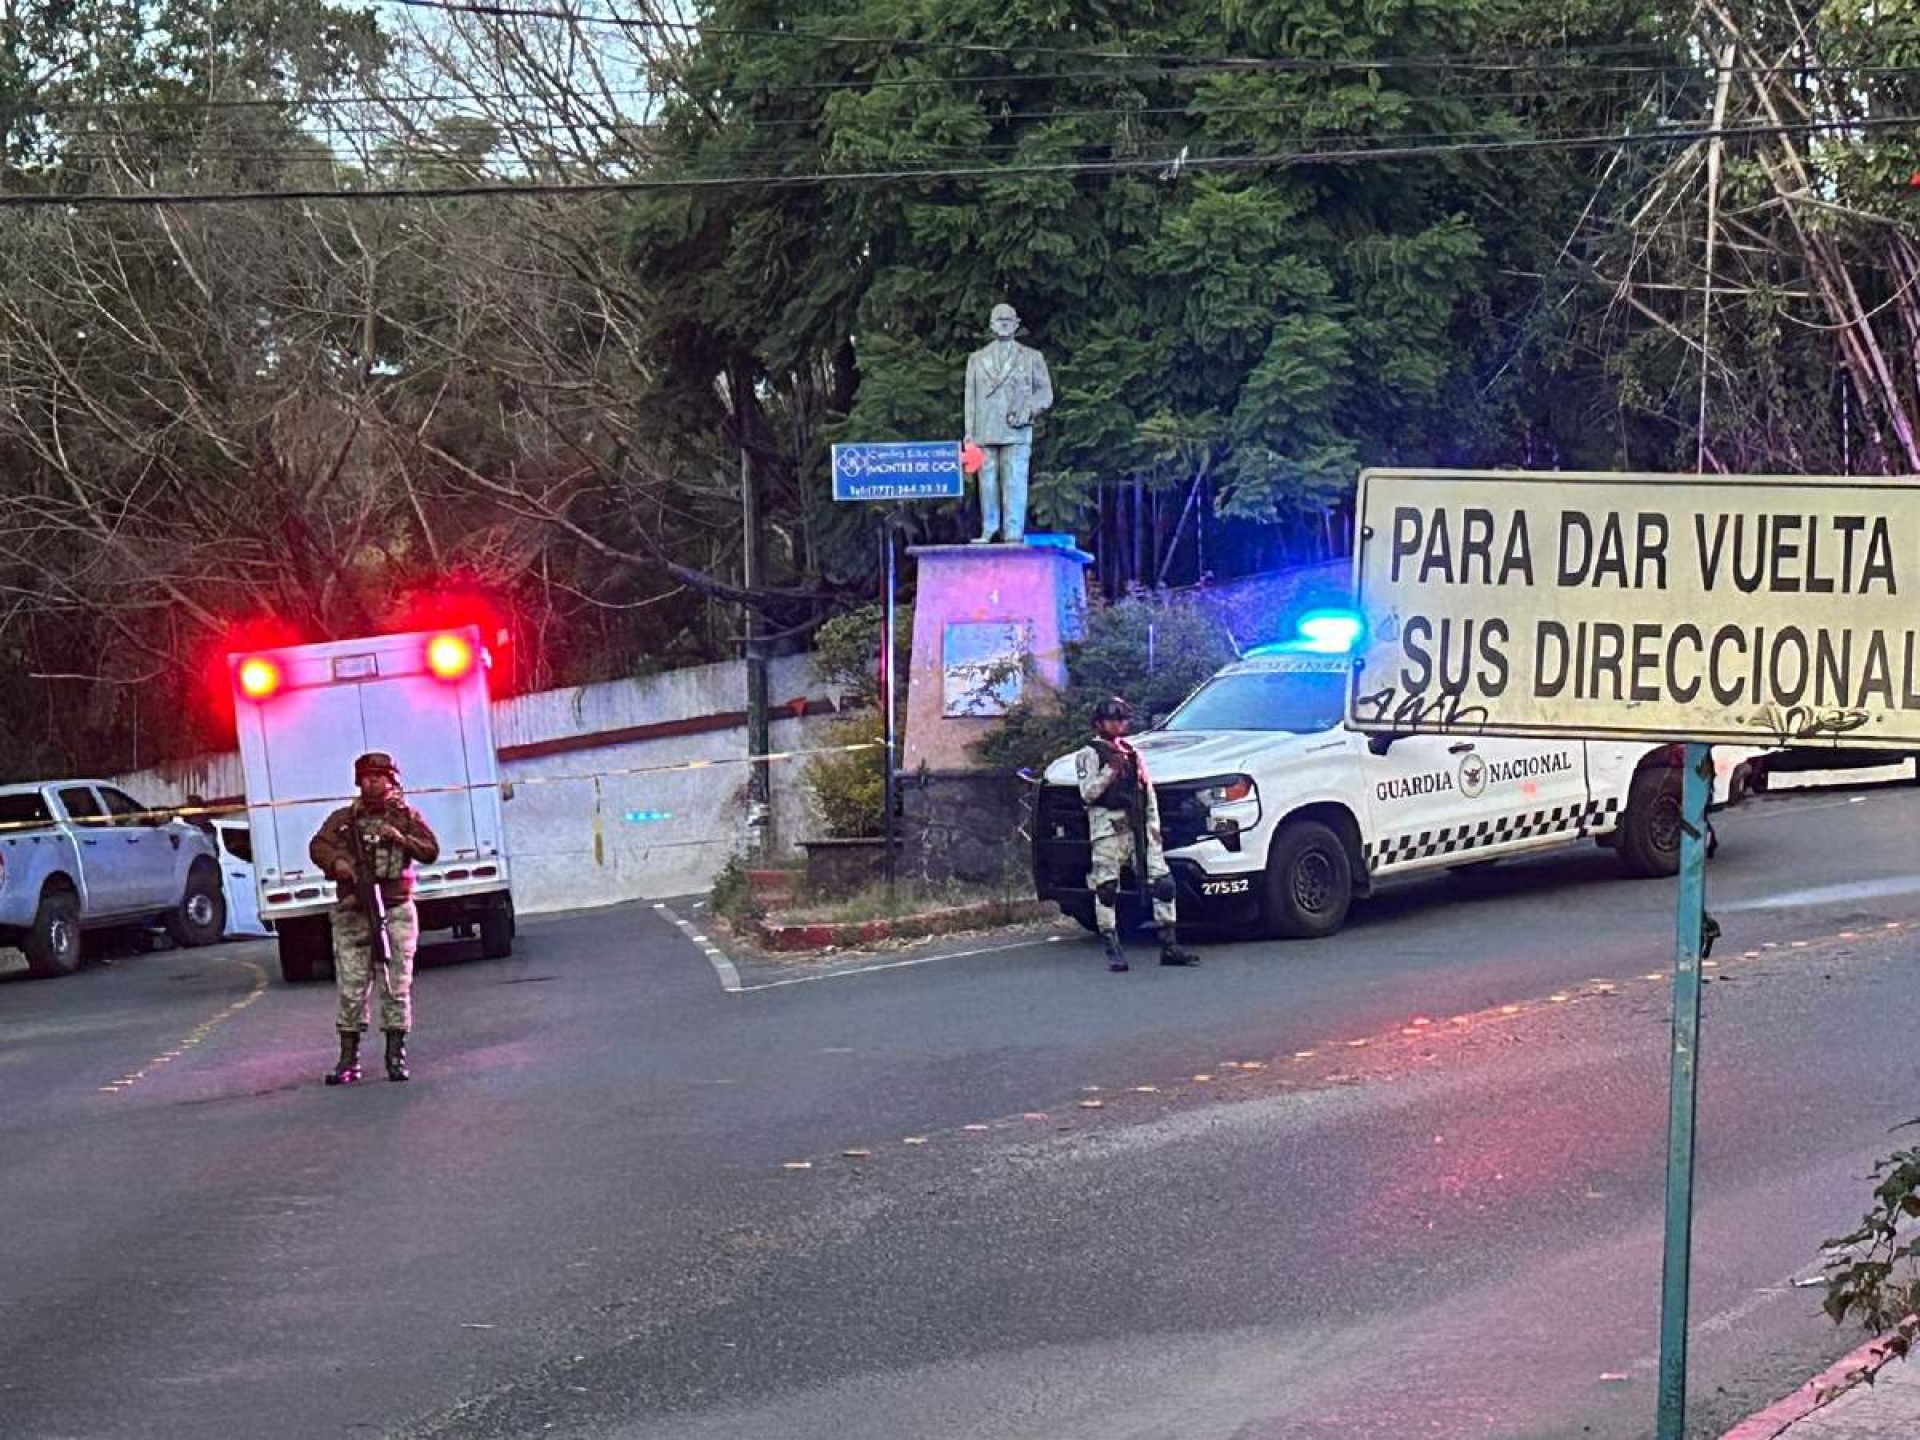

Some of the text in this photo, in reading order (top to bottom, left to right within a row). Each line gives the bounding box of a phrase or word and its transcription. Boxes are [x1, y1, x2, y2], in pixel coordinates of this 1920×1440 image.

[915, 461, 929, 473] DE
[1391, 506, 1897, 595] PARA DAR VUELTA
[1400, 615, 1509, 698] SUS
[1534, 620, 1920, 710] DIRECCIONAL
[1377, 752, 1571, 801] GUARDIA NACIONAL
[1201, 879, 1249, 895] 27552
